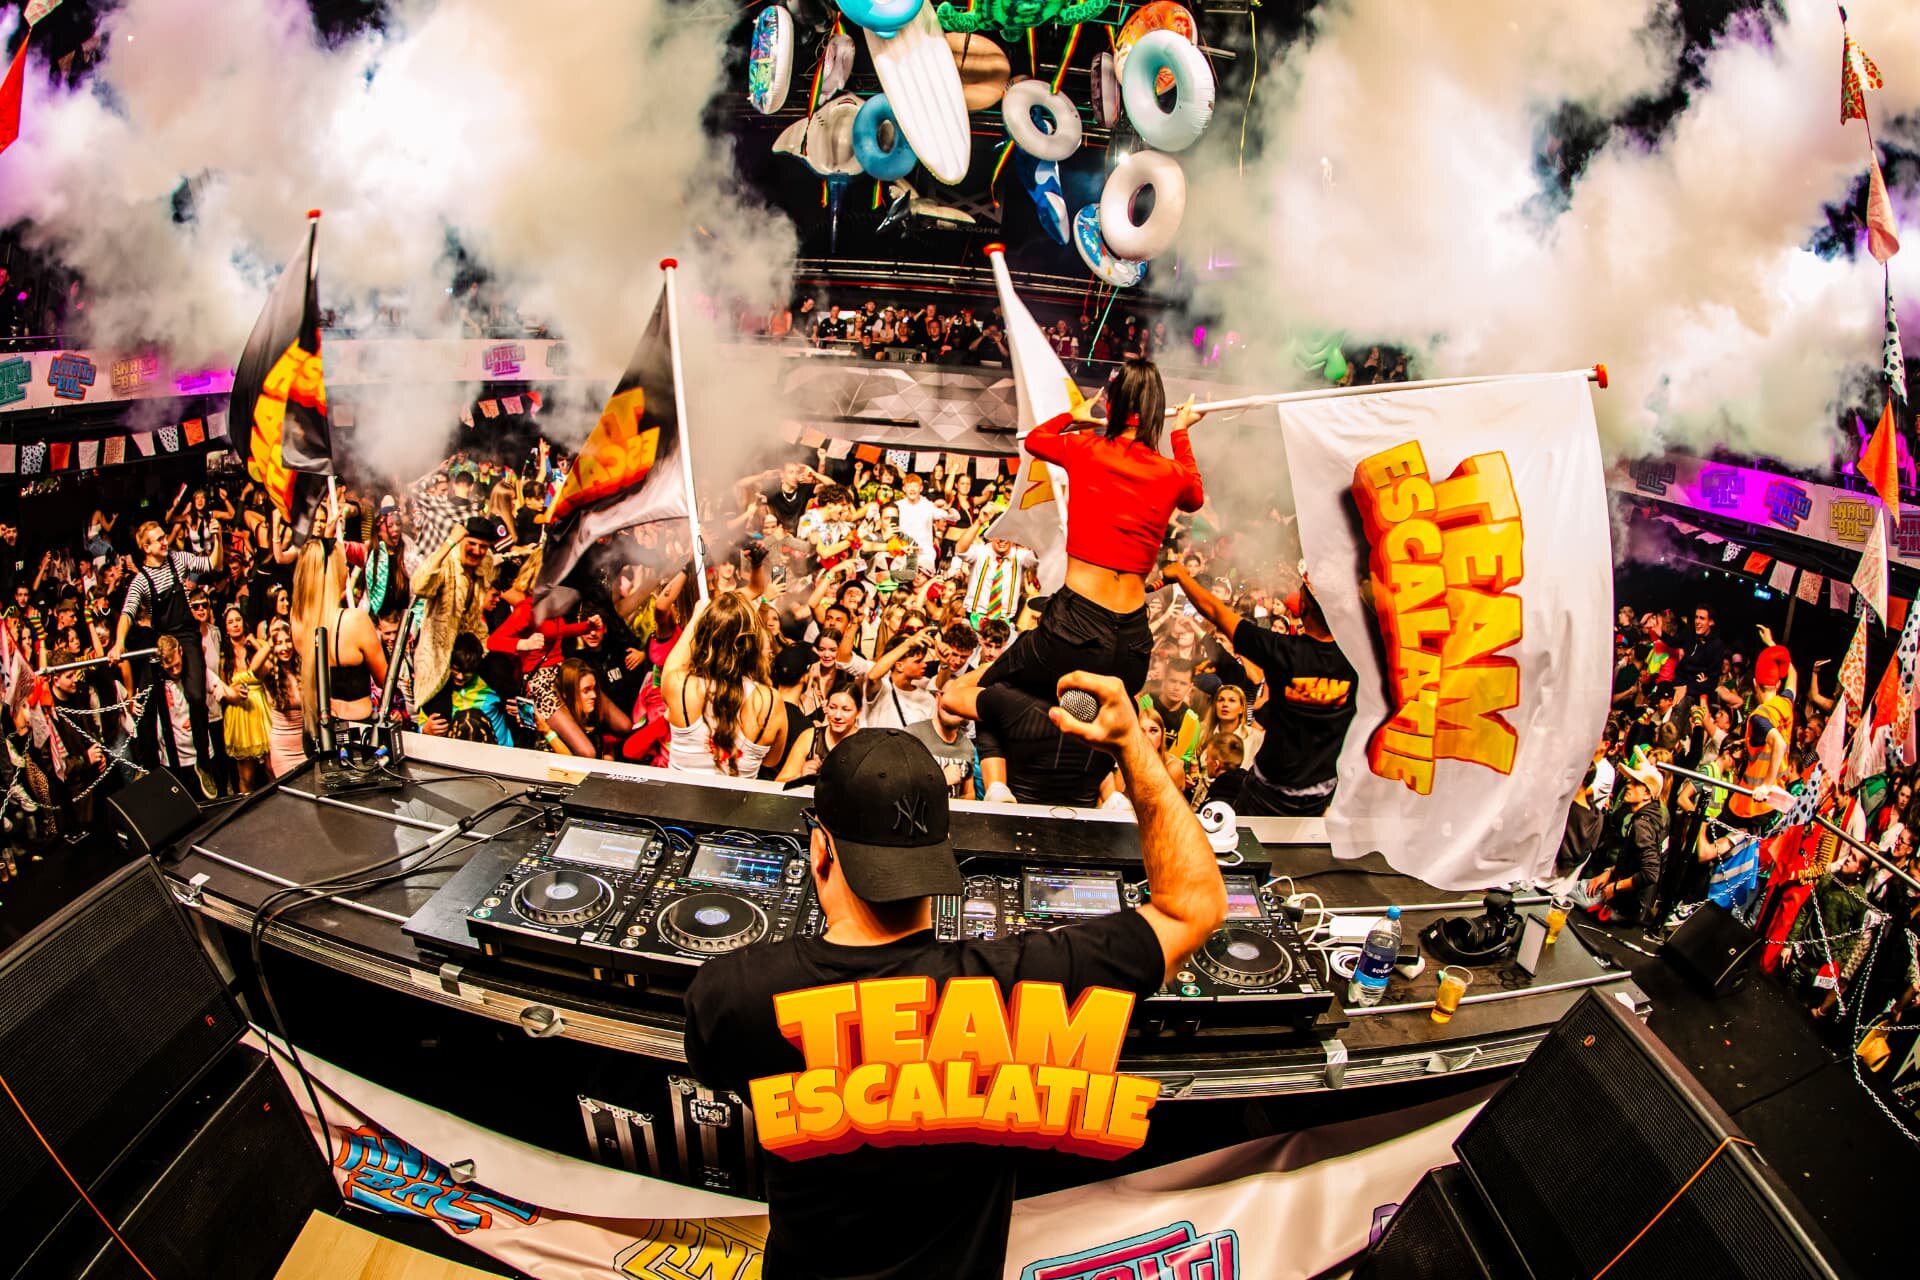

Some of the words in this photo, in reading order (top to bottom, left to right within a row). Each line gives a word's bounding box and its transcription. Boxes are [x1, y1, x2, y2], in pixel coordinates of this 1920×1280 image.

[1837, 519, 1865, 536] BAL
[1358, 440, 1450, 796] ESCALATIE
[1432, 450, 1523, 776] TEAM
[1291, 676, 1351, 697] TEAM
[773, 976, 1136, 1074] TEAM
[749, 1060, 1160, 1148] ESCALATIE
